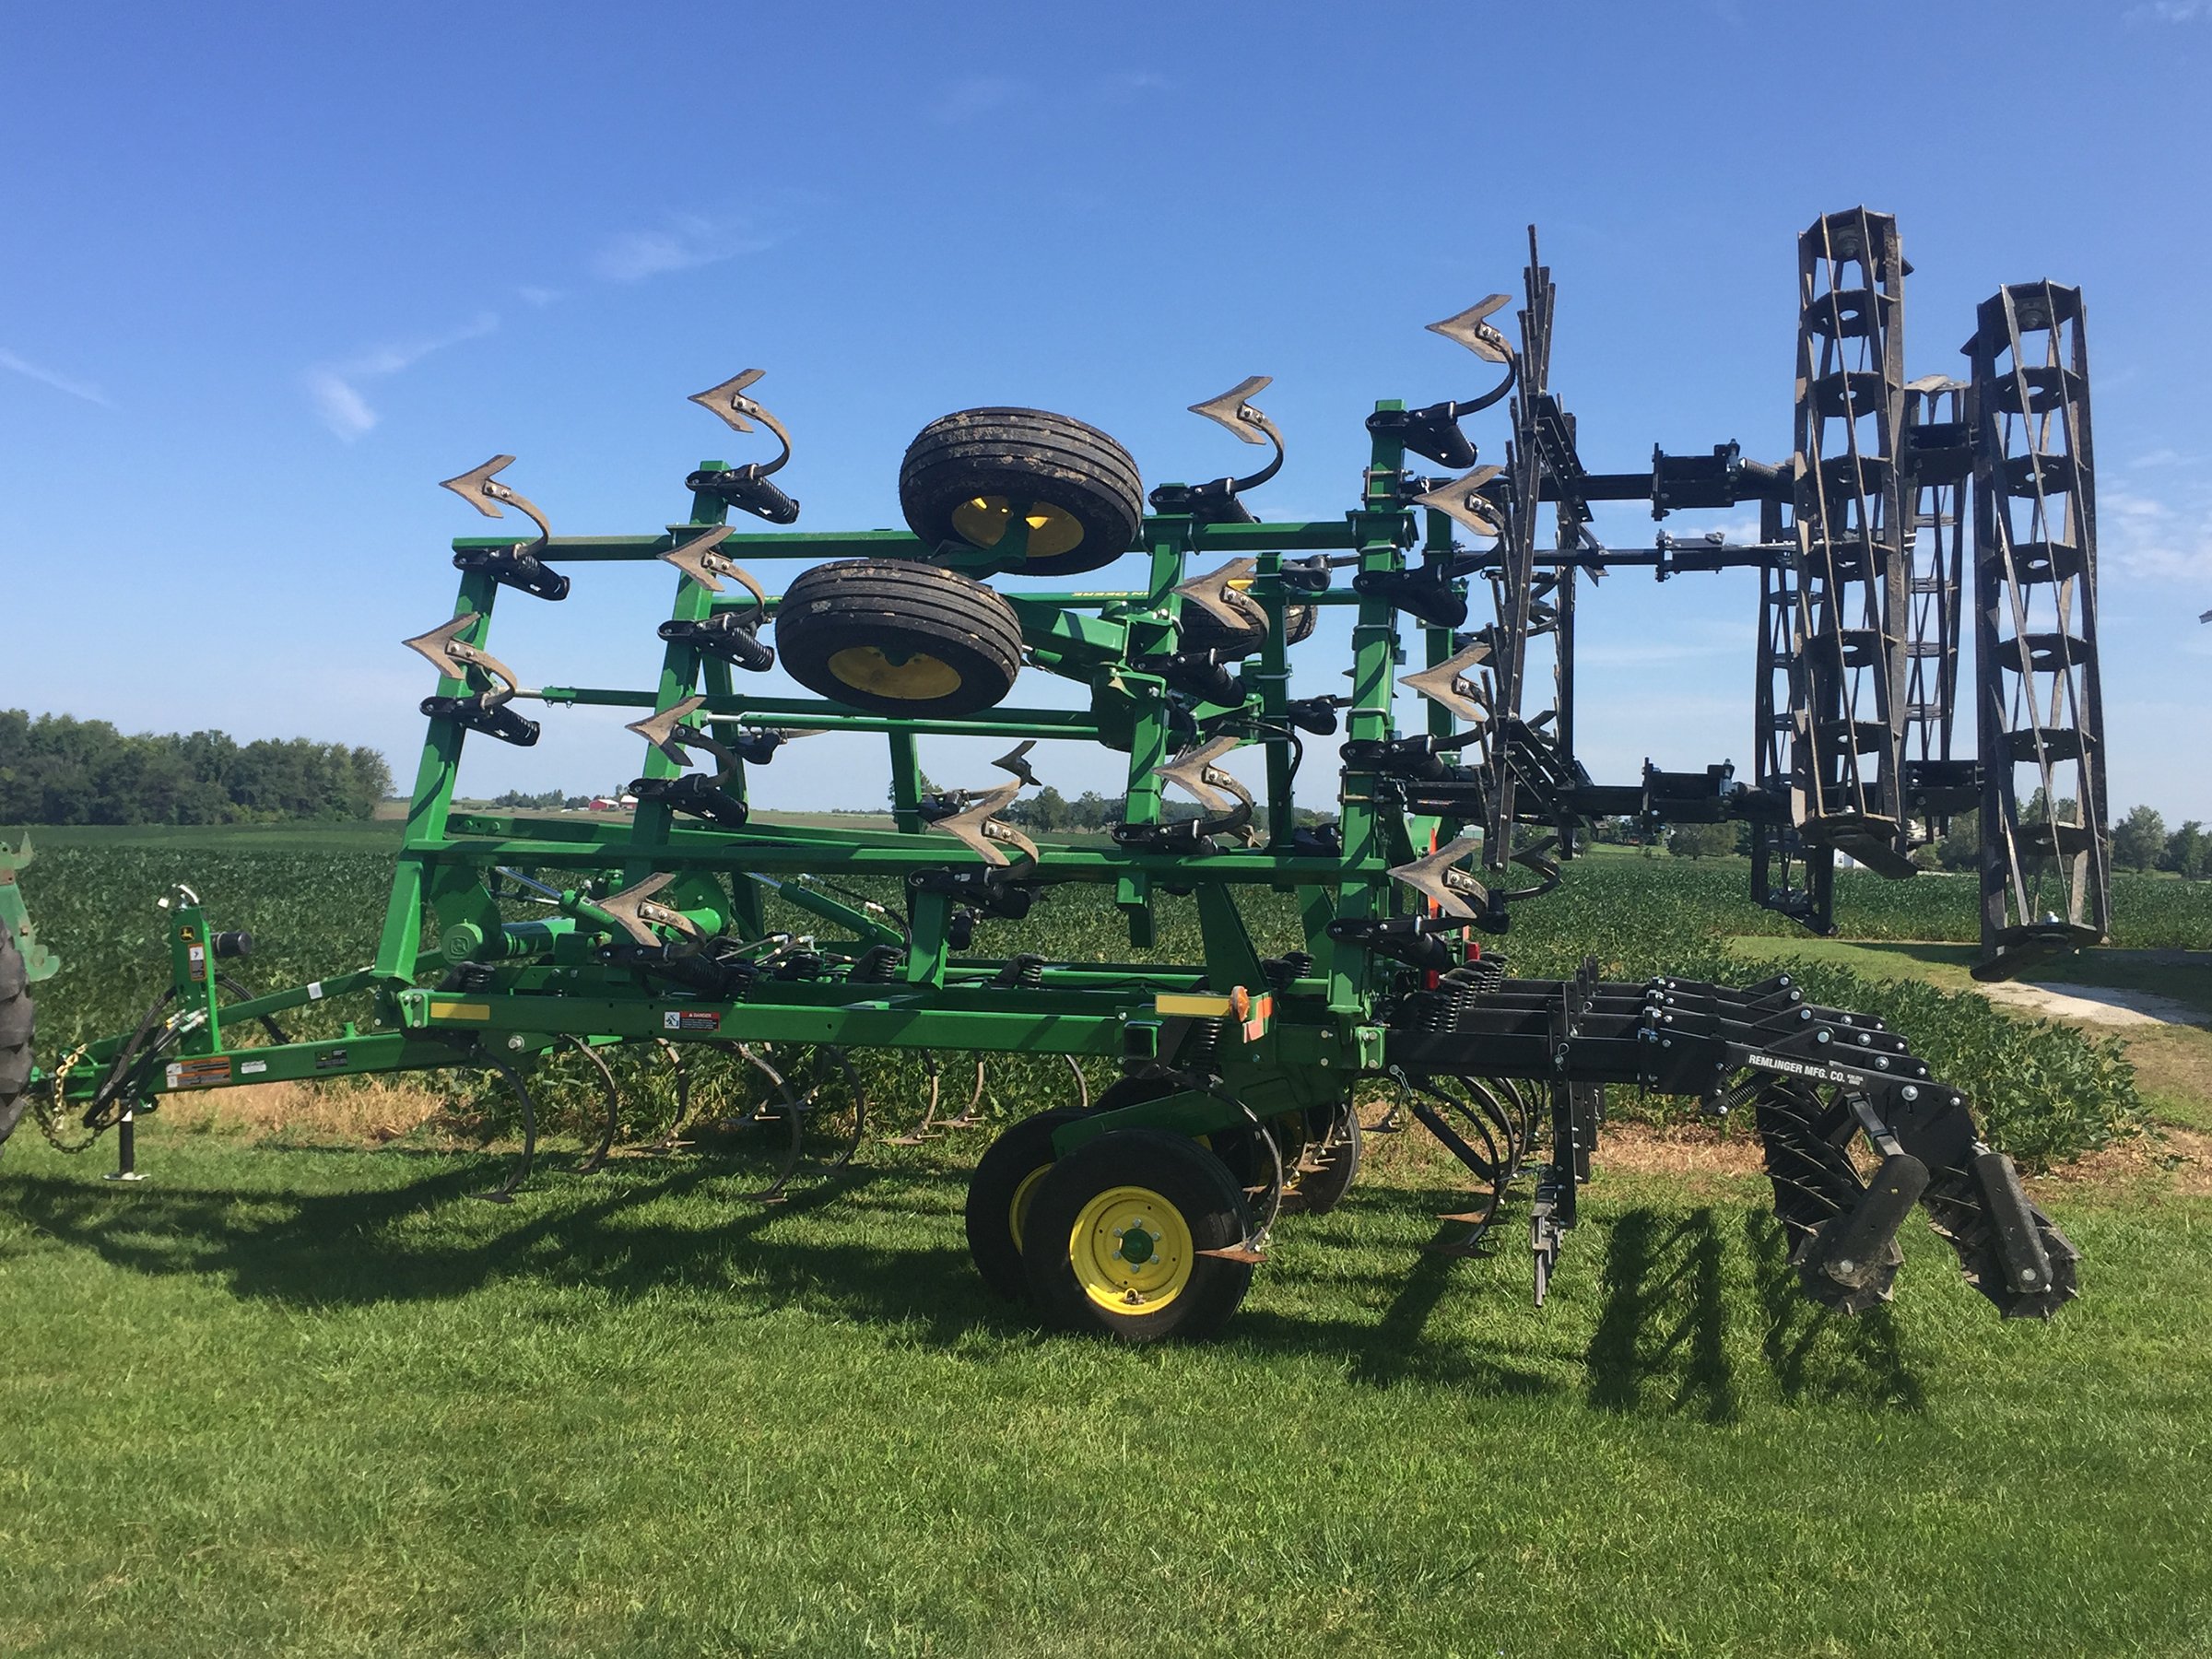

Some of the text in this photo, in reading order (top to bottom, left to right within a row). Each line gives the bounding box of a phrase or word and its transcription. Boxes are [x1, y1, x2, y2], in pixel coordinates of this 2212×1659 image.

[1748, 1054, 1803, 1074] REMLINGER
[1805, 1065, 1828, 1079] MFG.
[1830, 1071, 1845, 1083] CO.
